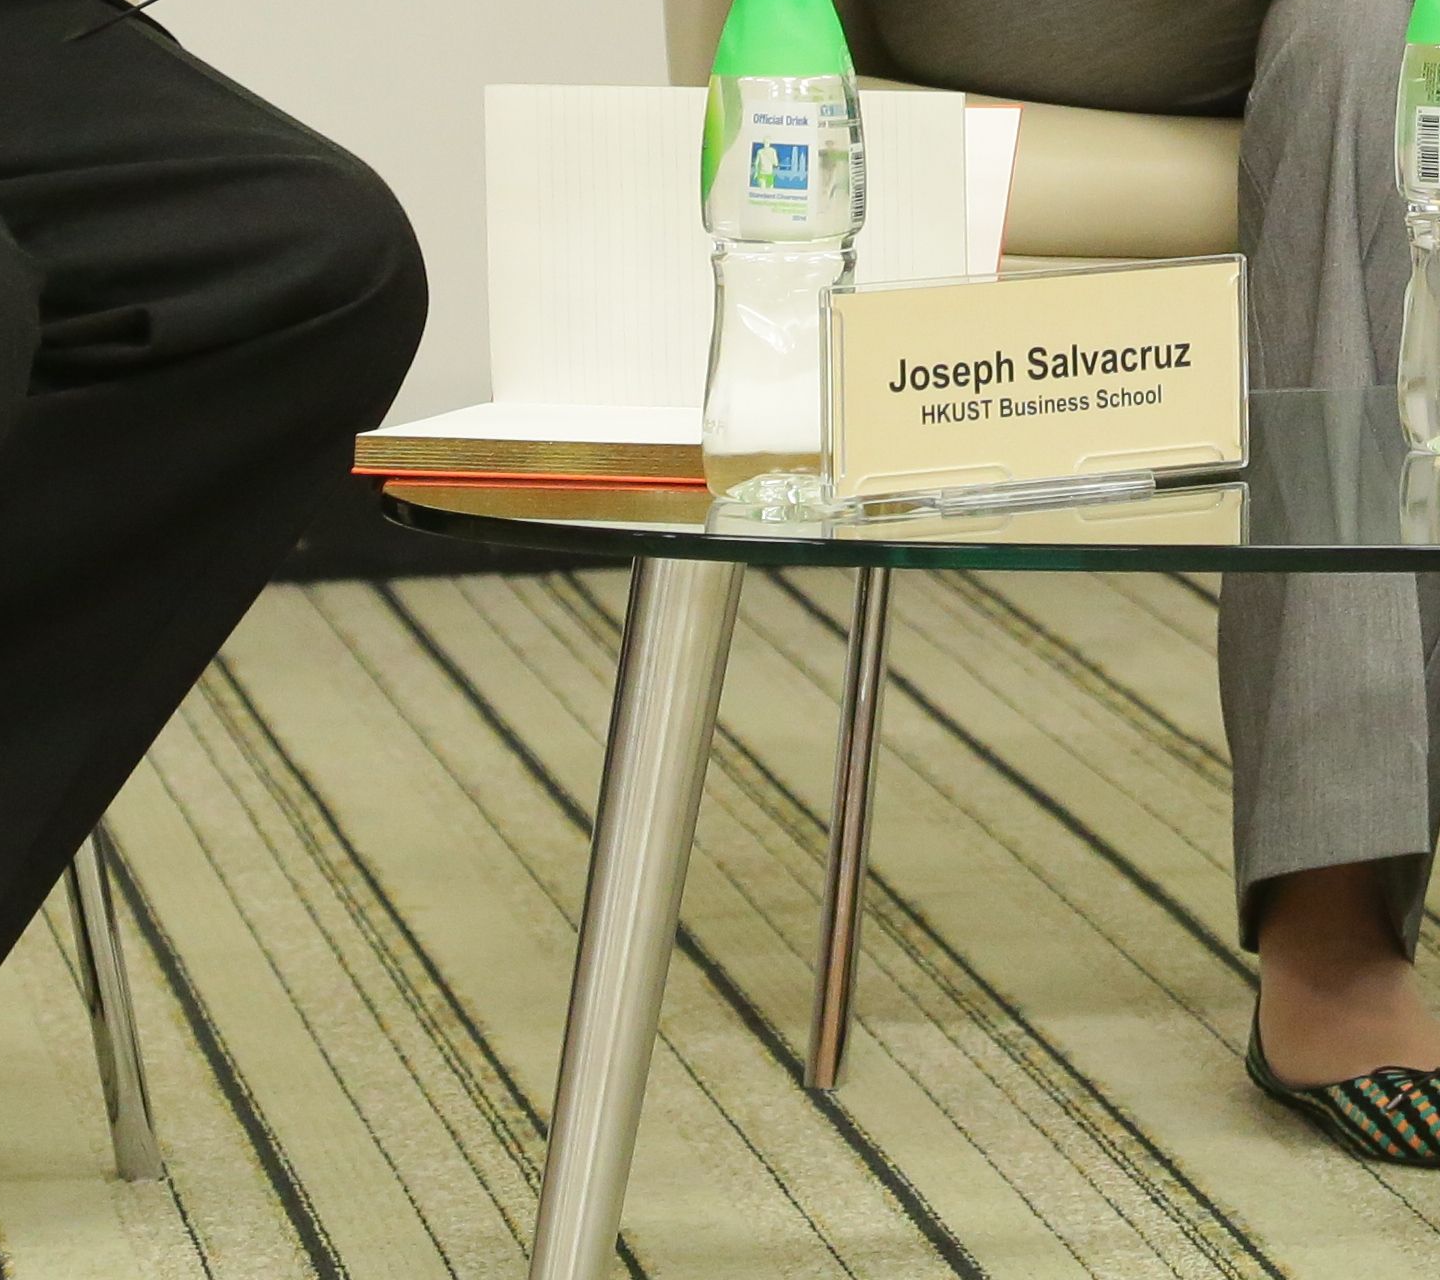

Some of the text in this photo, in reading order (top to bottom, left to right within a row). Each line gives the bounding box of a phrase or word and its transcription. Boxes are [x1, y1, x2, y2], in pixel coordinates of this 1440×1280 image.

[753, 113, 784, 126] Official
[786, 115, 809, 126] Drink
[888, 342, 1191, 394] Joseph Salvacruz
[921, 384, 1163, 425] HKUST Business School
